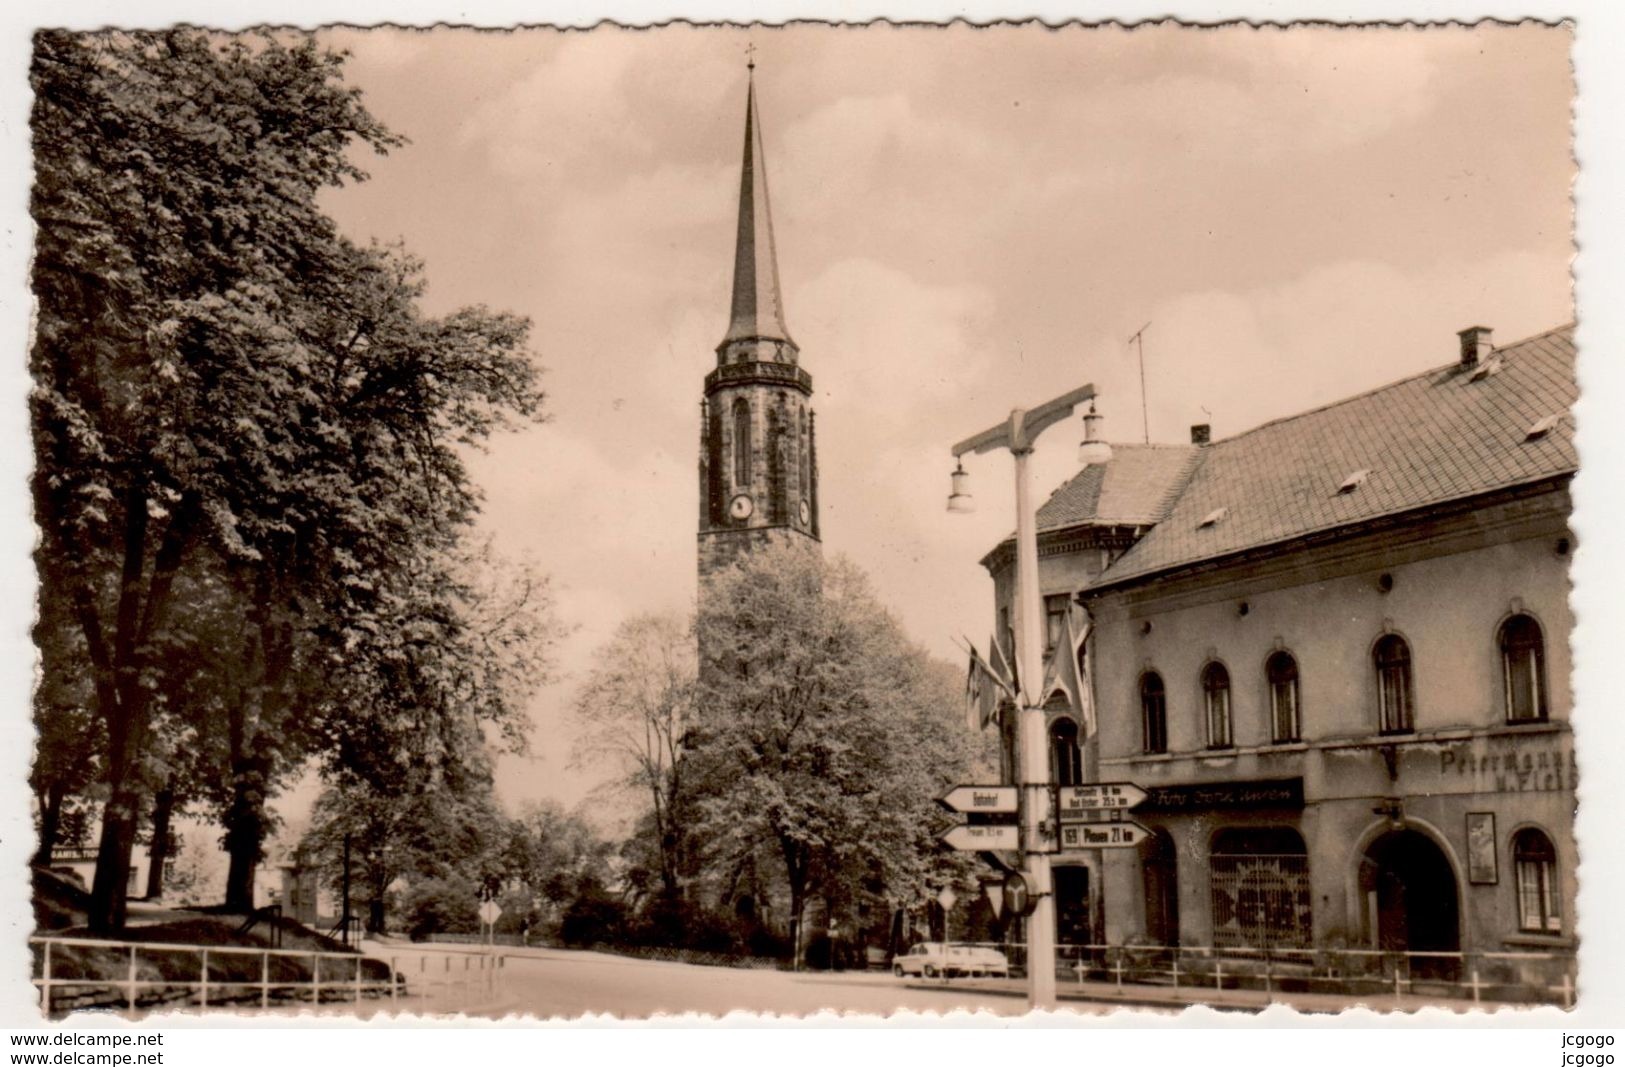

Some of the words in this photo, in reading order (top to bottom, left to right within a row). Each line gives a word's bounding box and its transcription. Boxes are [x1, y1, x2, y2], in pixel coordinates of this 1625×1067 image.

[973, 791, 998, 807] Bahnhof
[1084, 827, 1108, 843] Plauen
[1111, 827, 1120, 843] 21
[1123, 827, 1133, 842] km
